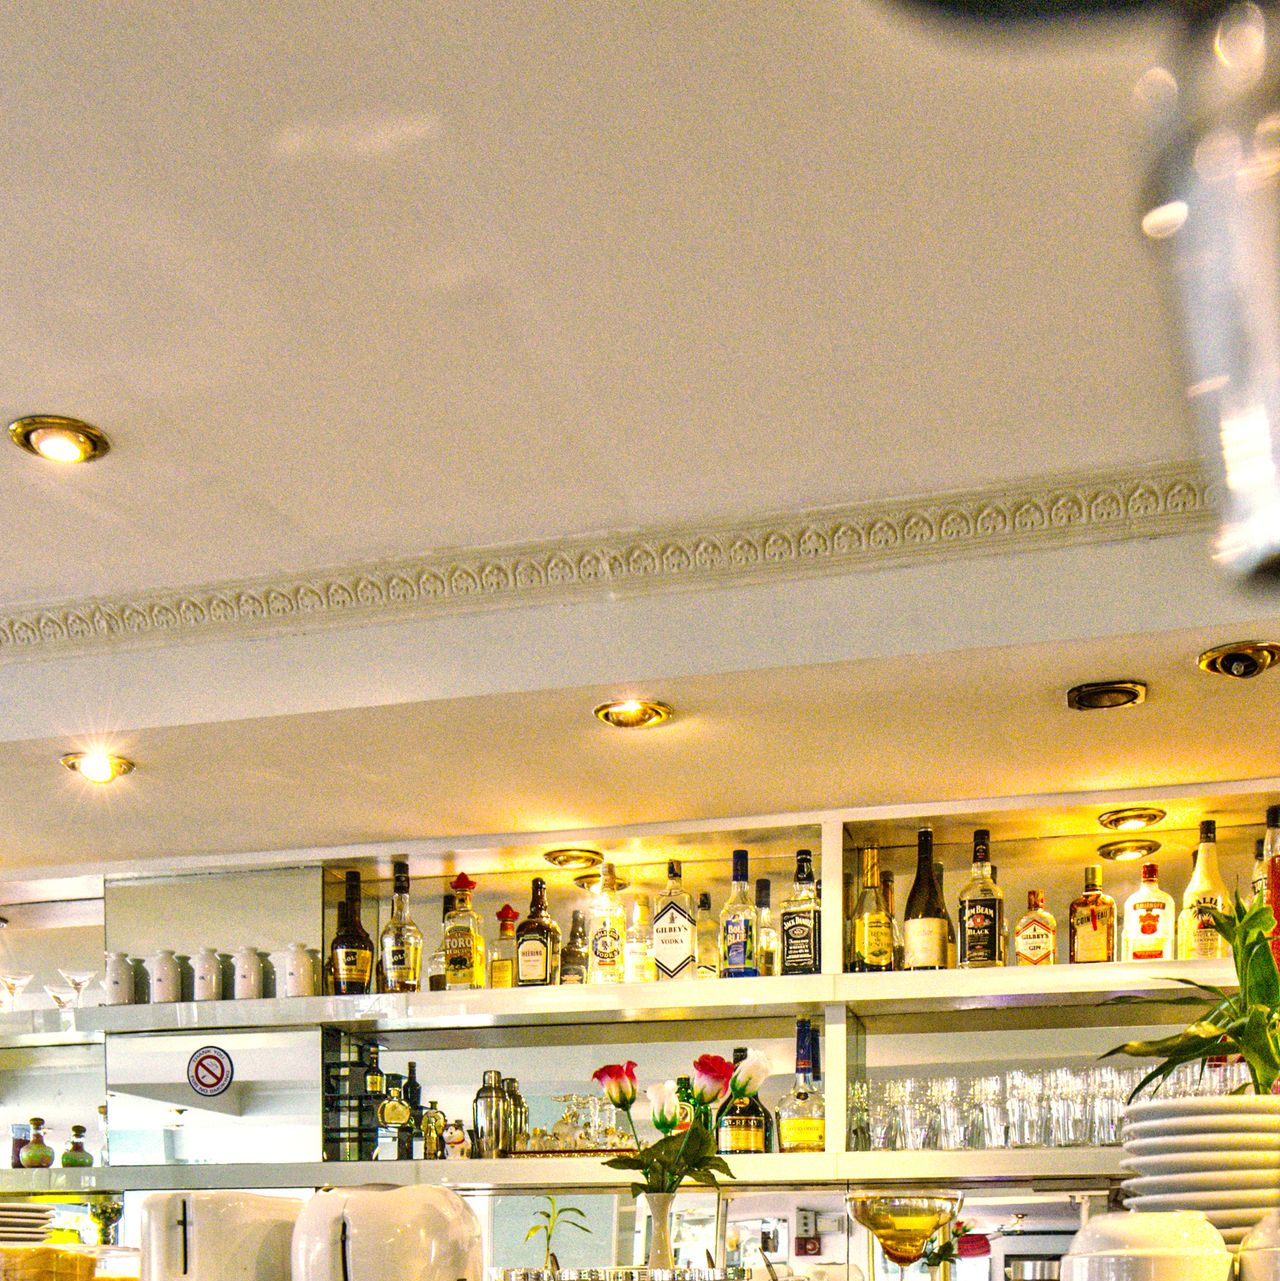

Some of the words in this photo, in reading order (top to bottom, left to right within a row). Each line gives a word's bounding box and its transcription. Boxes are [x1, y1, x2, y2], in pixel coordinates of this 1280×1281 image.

[976, 905, 993, 918] BEAM
[1076, 910, 1108, 926] COINEAU
[656, 924, 688, 933] GILBEY'S
[446, 937, 473, 949] TORO
[213, 1050, 226, 1060] YOU
